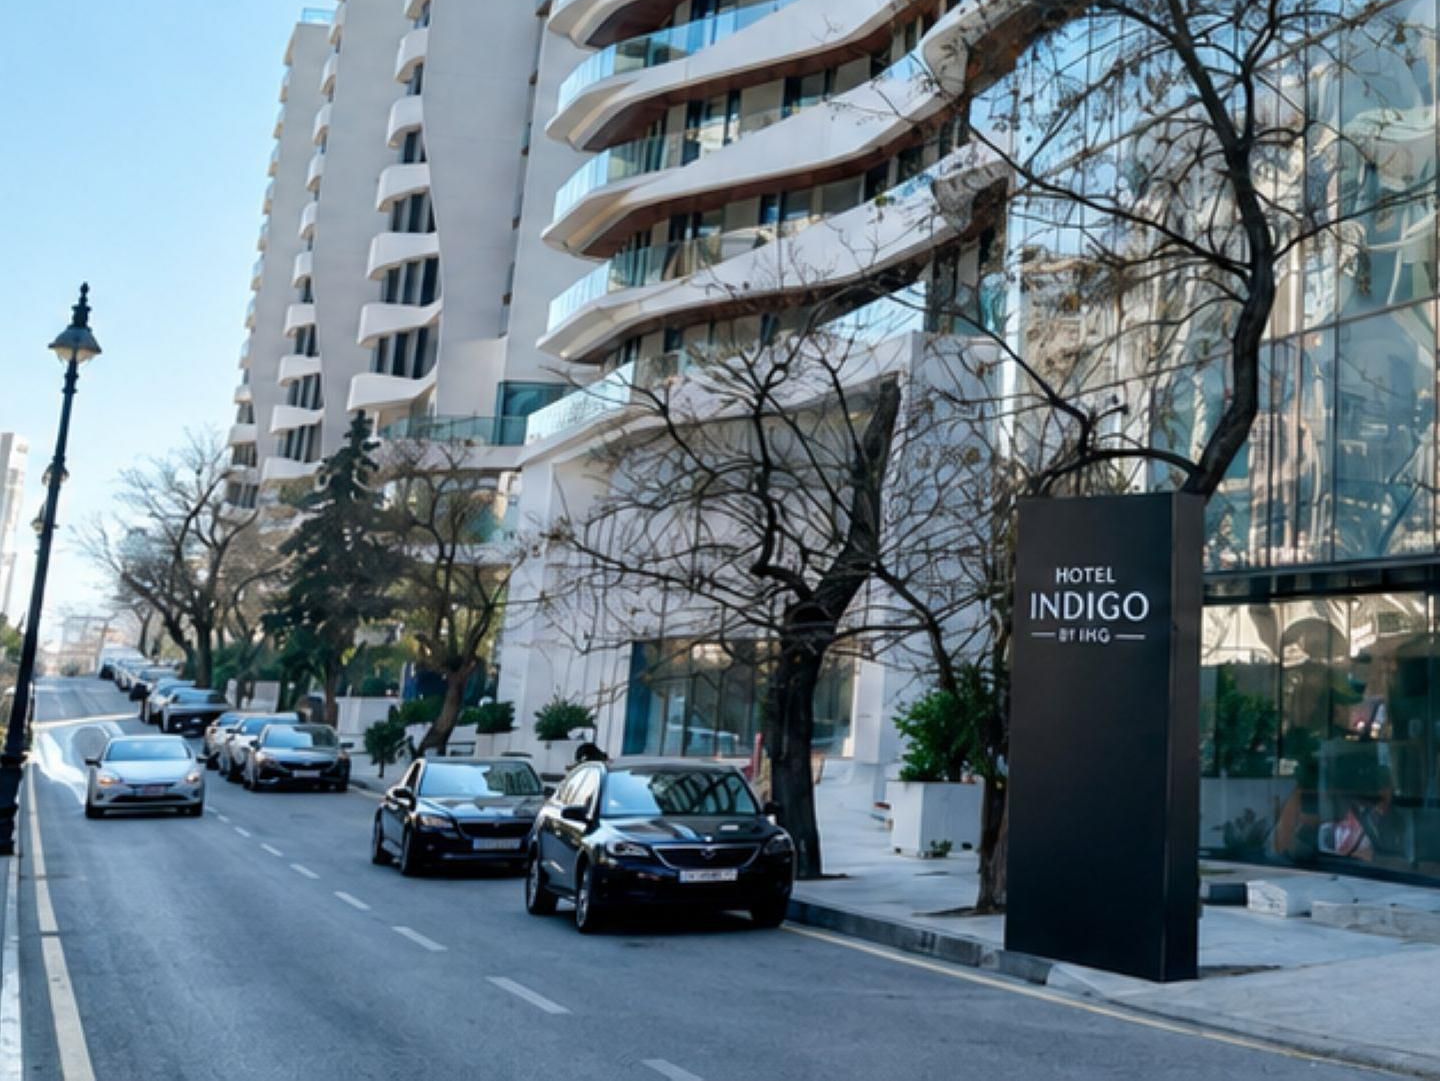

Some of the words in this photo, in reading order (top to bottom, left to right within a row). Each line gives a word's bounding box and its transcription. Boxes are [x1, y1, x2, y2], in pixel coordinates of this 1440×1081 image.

[1056, 567, 1117, 584] HOTEL
[1030, 591, 1149, 622] INDIGO
[1079, 628, 1111, 643] IHG
